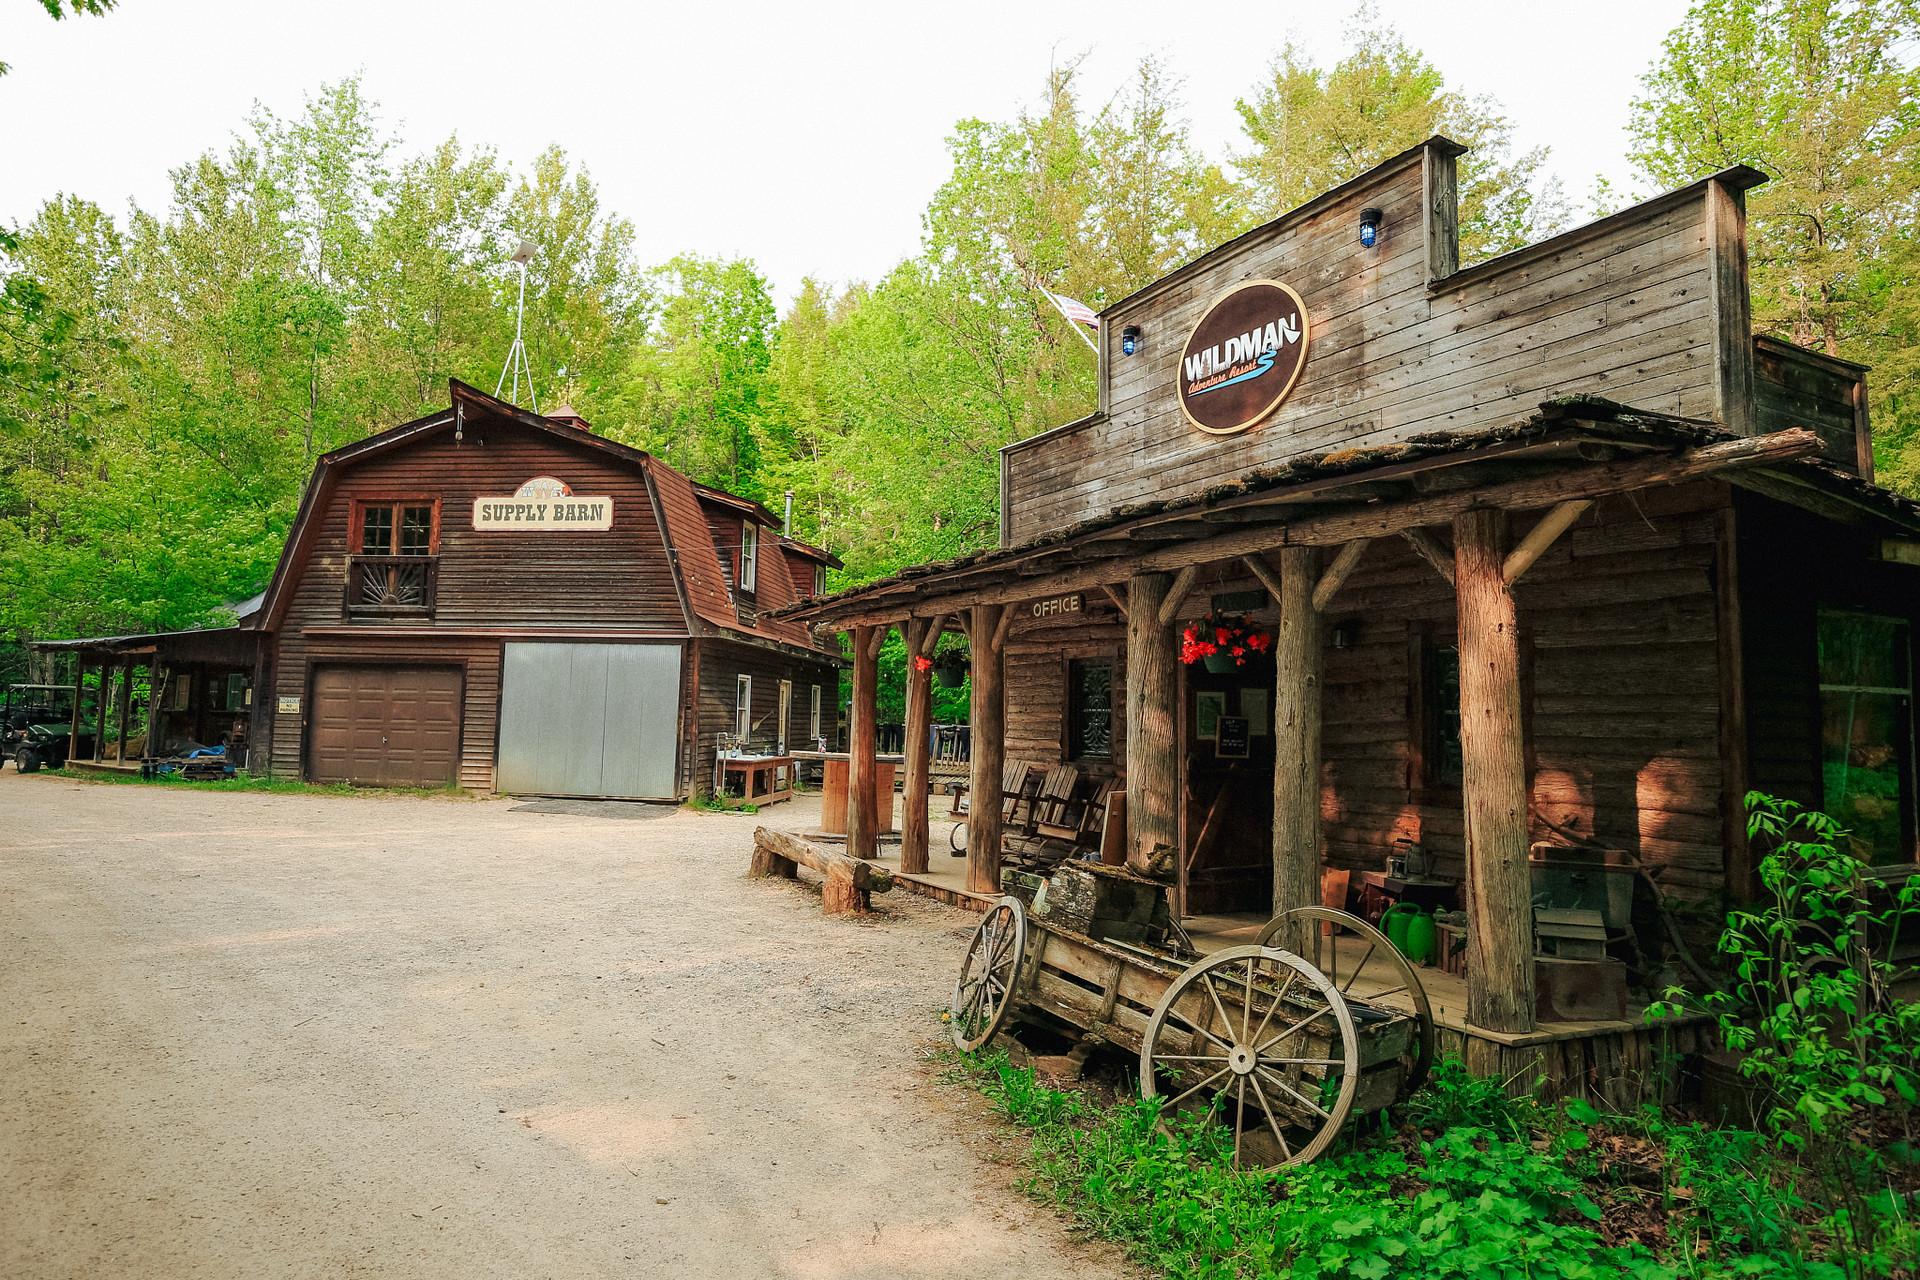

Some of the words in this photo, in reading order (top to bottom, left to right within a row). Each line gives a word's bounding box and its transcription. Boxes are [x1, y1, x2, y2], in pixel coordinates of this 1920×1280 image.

[1184, 312, 1301, 382] WILDMAN
[1188, 374, 1226, 394] Adventure
[1228, 358, 1258, 379] Resort
[482, 504, 547, 521] SUPPLY
[553, 504, 604, 521] BARN
[1033, 595, 1079, 617] OFFICE
